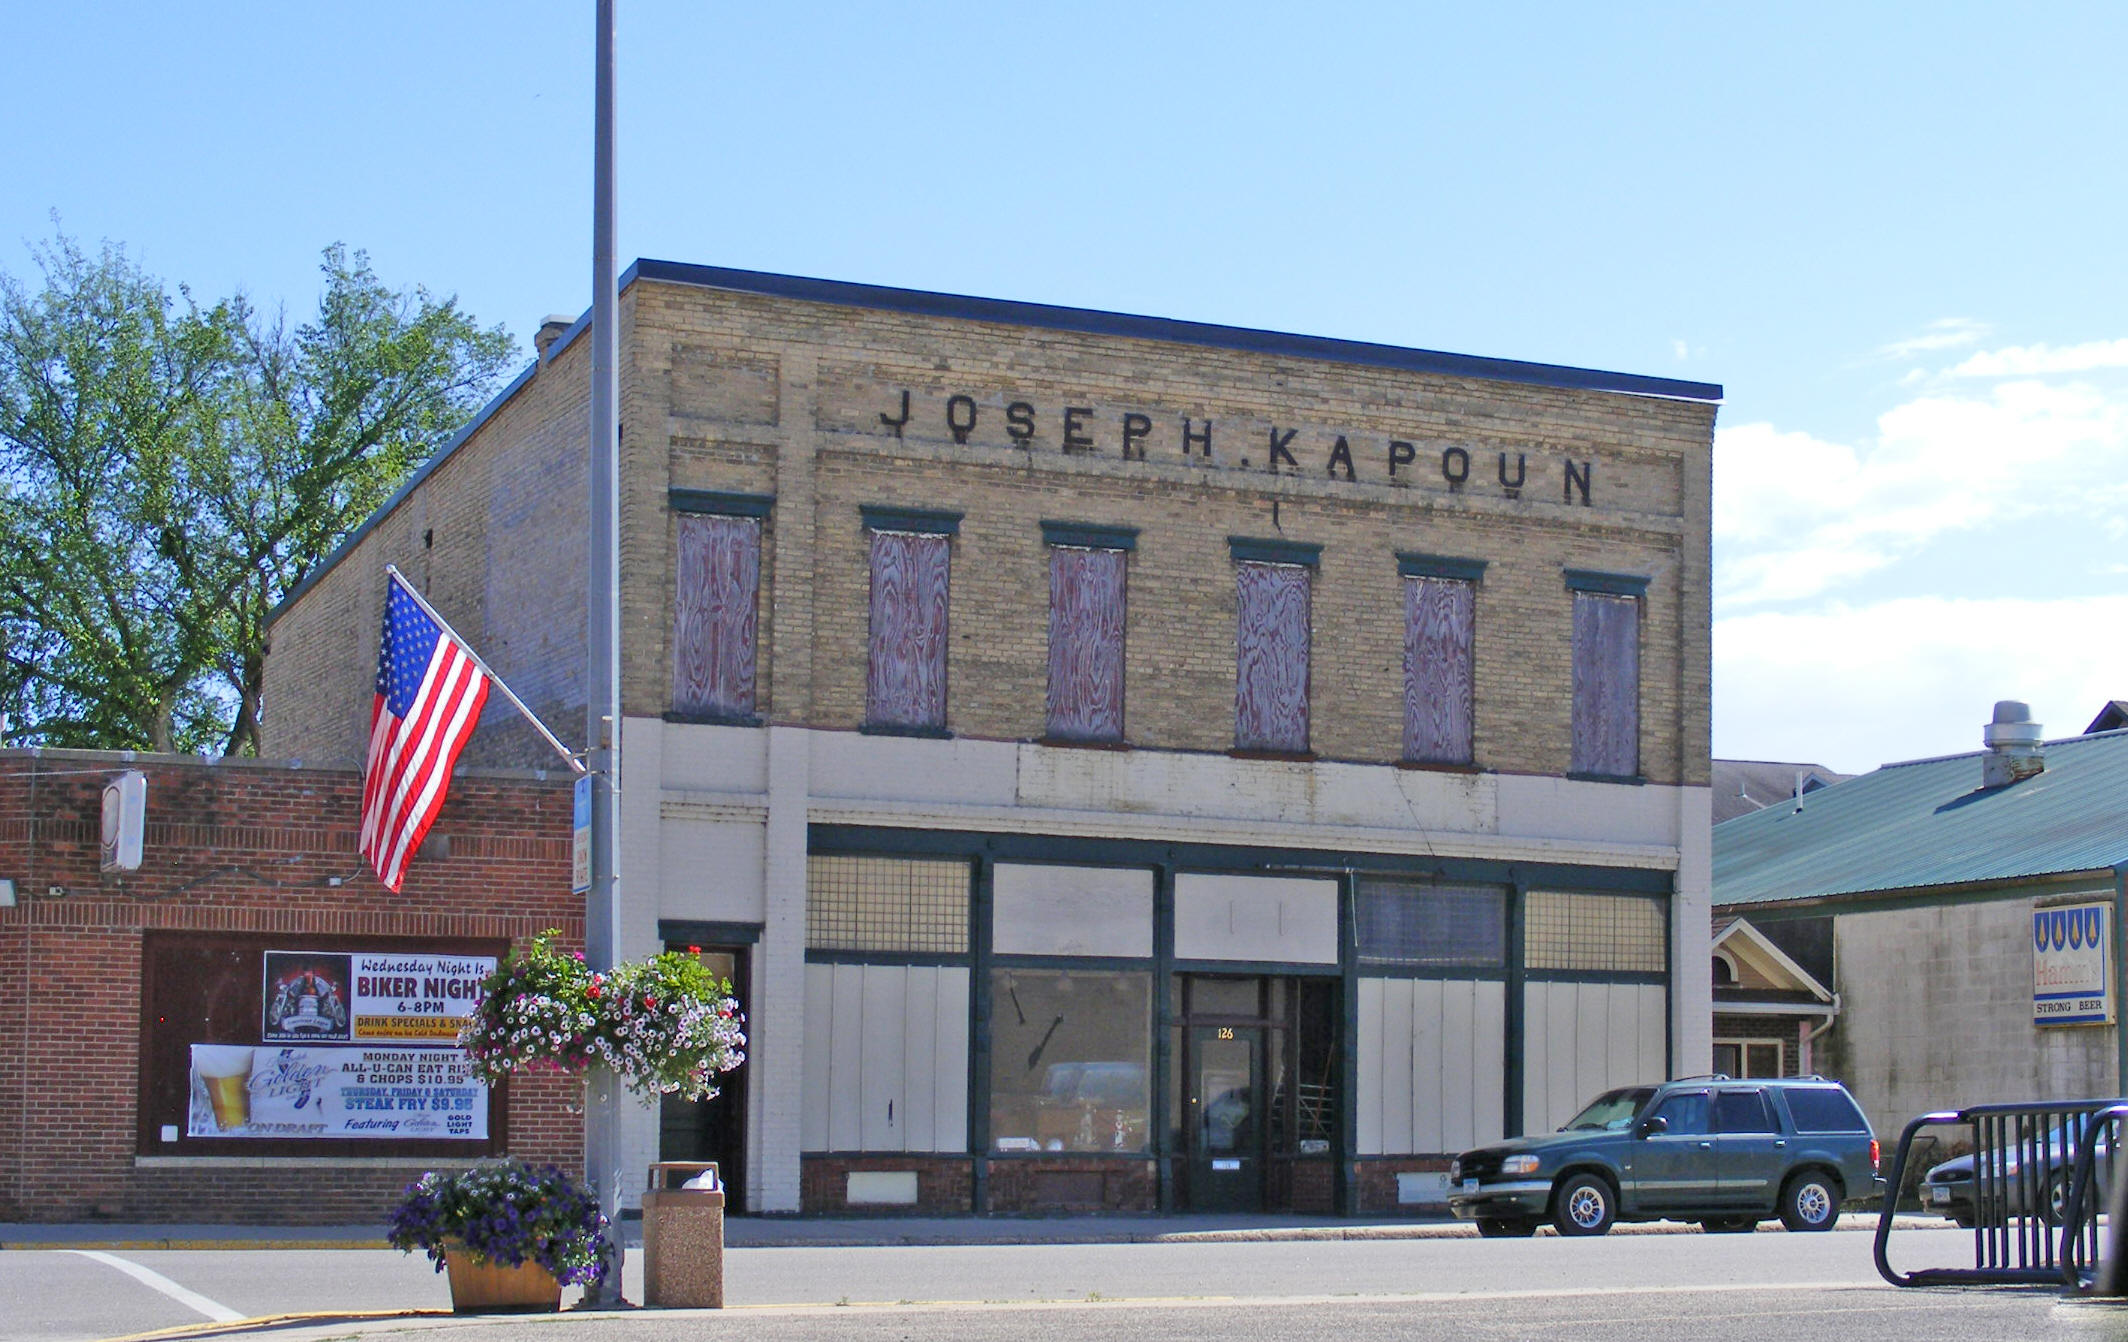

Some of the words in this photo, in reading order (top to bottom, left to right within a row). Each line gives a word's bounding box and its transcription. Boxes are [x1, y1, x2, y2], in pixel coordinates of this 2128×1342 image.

[1269, 427, 1592, 505] KAPOUN
[361, 959, 432, 975] Wednesday
[437, 961, 470, 974] Night
[357, 976, 417, 998] BIKER
[397, 1001, 444, 1013] 6-8PM
[2036, 1002, 2071, 1013] STRONG
[2079, 1001, 2102, 1011] BEER
[358, 1017, 388, 1027] DRINK
[391, 1018, 436, 1028] SPECIALS
[439, 1019, 447, 1028] &
[1218, 1028, 1233, 1040] 126
[363, 1053, 415, 1062] MONDAY
[420, 1054, 458, 1062] NIGHT
[342, 1064, 413, 1073] ALL-U-CAN
[418, 1065, 443, 1073] EAT
[370, 1075, 413, 1084] CHOPS
[418, 1075, 464, 1085] $10.95
[392, 1087, 422, 1097] FRIDAY
[434, 1088, 478, 1098] SATURDAY
[345, 1098, 394, 1110] STEAK
[399, 1098, 427, 1110] FRY
[275, 1123, 328, 1134] DRAFT
[344, 1118, 400, 1131] Featuring
